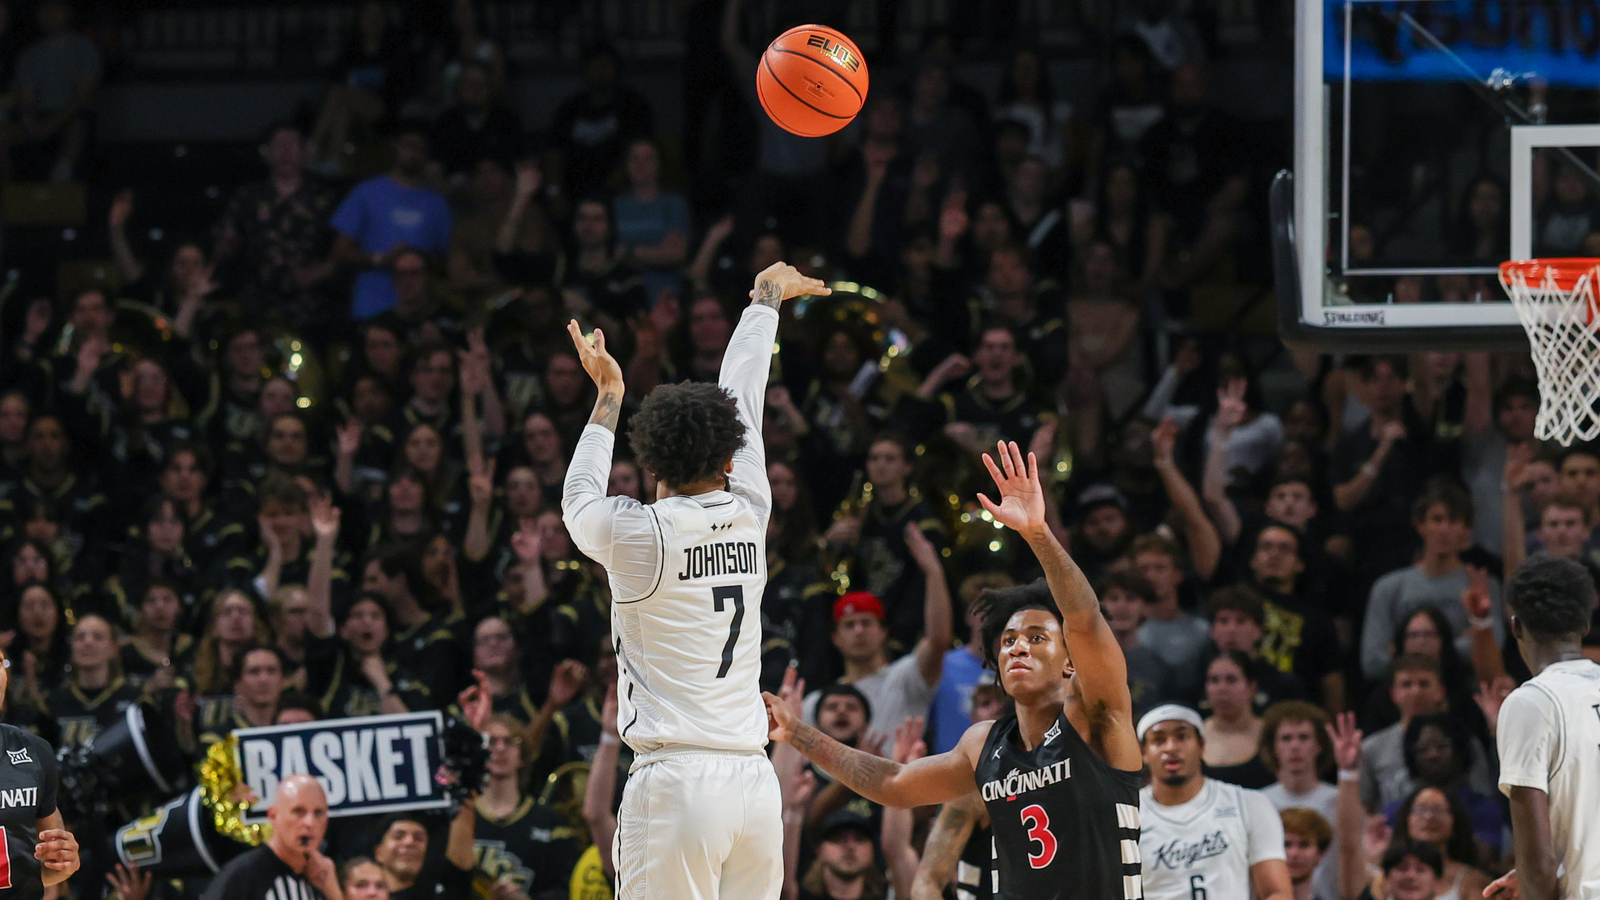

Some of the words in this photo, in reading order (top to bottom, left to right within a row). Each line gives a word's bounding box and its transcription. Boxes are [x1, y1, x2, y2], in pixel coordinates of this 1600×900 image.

[807, 34, 860, 73] ELITE
[678, 542, 758, 581] JOHNSON
[711, 584, 745, 678] 7
[243, 723, 434, 813] BASKET
[981, 757, 1072, 802] CINCINNATI
[1020, 803, 1058, 870] 3
[1152, 829, 1229, 871] Knights
[1190, 874, 1207, 900] 6
